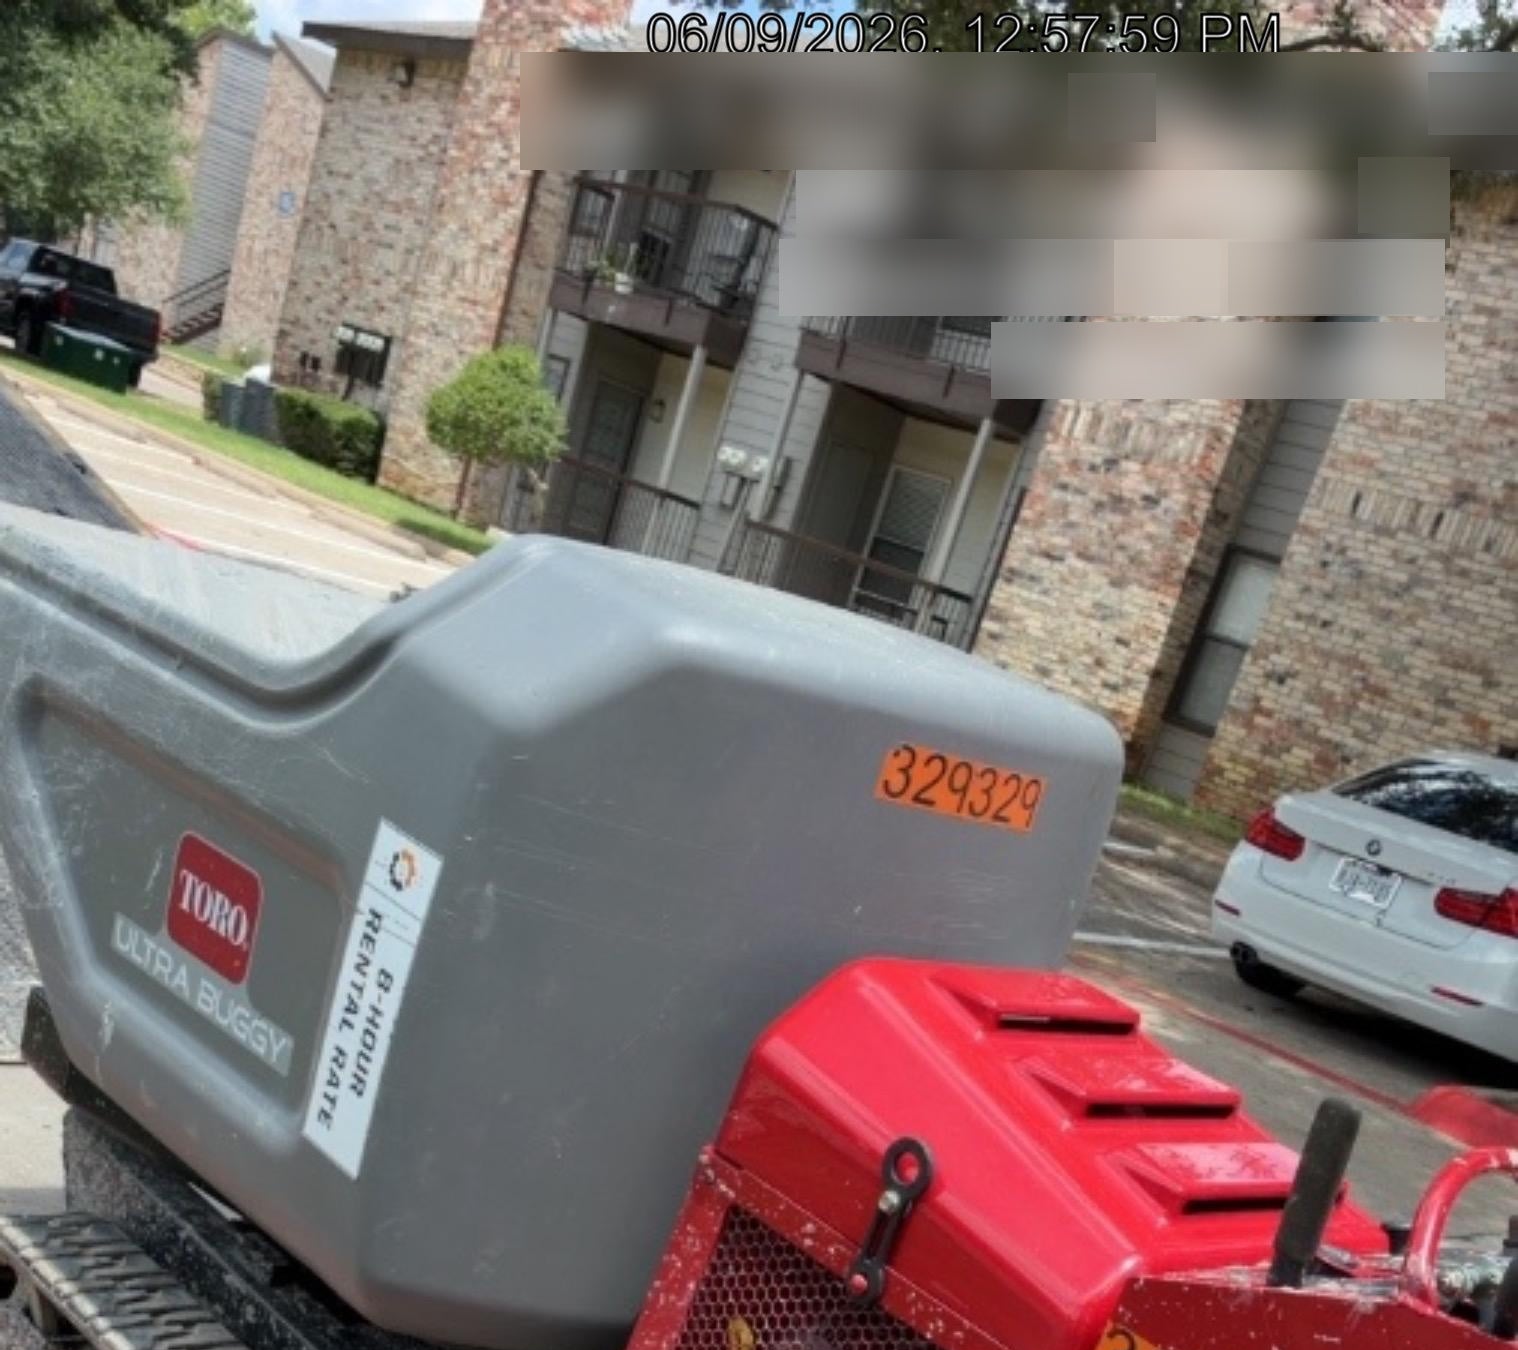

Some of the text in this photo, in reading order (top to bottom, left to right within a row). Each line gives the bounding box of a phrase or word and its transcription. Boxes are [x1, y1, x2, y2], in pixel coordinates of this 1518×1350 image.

[883, 744, 1041, 828] 329329
[179, 869, 248, 946] TORO
[116, 917, 288, 1064] ULTRA BUGGY
[317, 907, 383, 1130] RENTAL RATE
